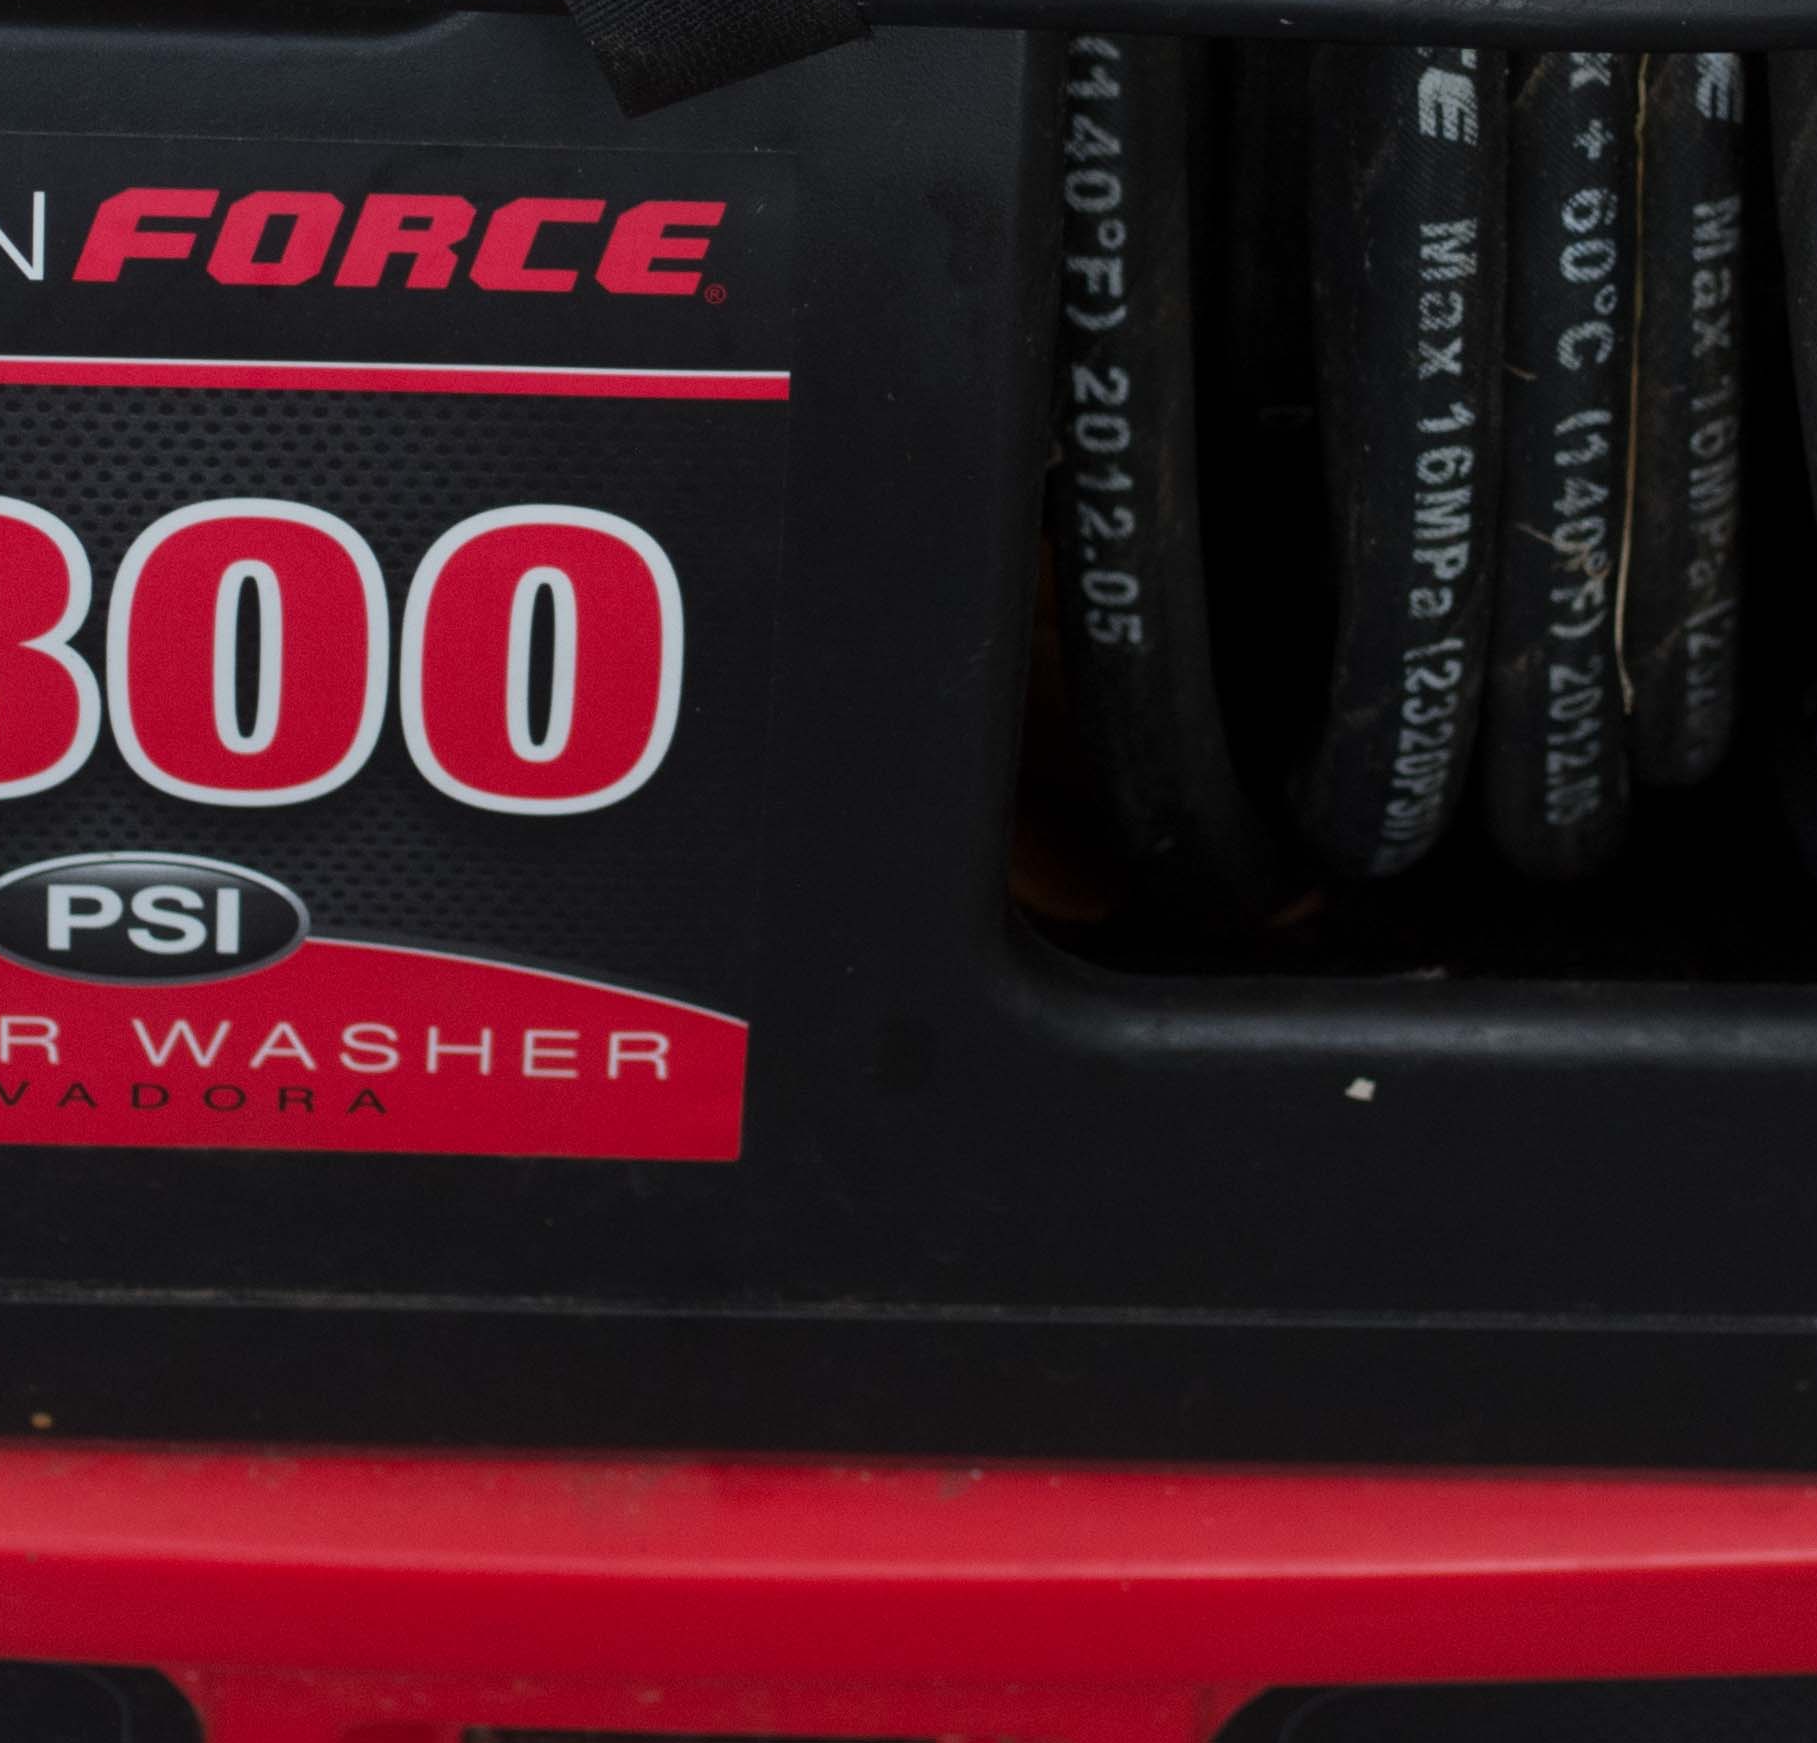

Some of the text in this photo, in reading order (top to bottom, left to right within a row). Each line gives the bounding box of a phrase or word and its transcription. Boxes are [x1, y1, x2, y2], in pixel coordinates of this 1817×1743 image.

[1572, 120, 1615, 160] +
[71, 186, 727, 295] FORCE
[1415, 218, 1477, 376] Max
[1556, 188, 1617, 372] 60°C
[1689, 199, 1741, 356] Max
[1069, 364, 1143, 647] 2012.05
[1407, 402, 1474, 619] 16MPa
[1686, 376, 1739, 590] 16MPa
[45, 883, 243, 957] PSI
[132, 1018, 671, 1082] WASHER
